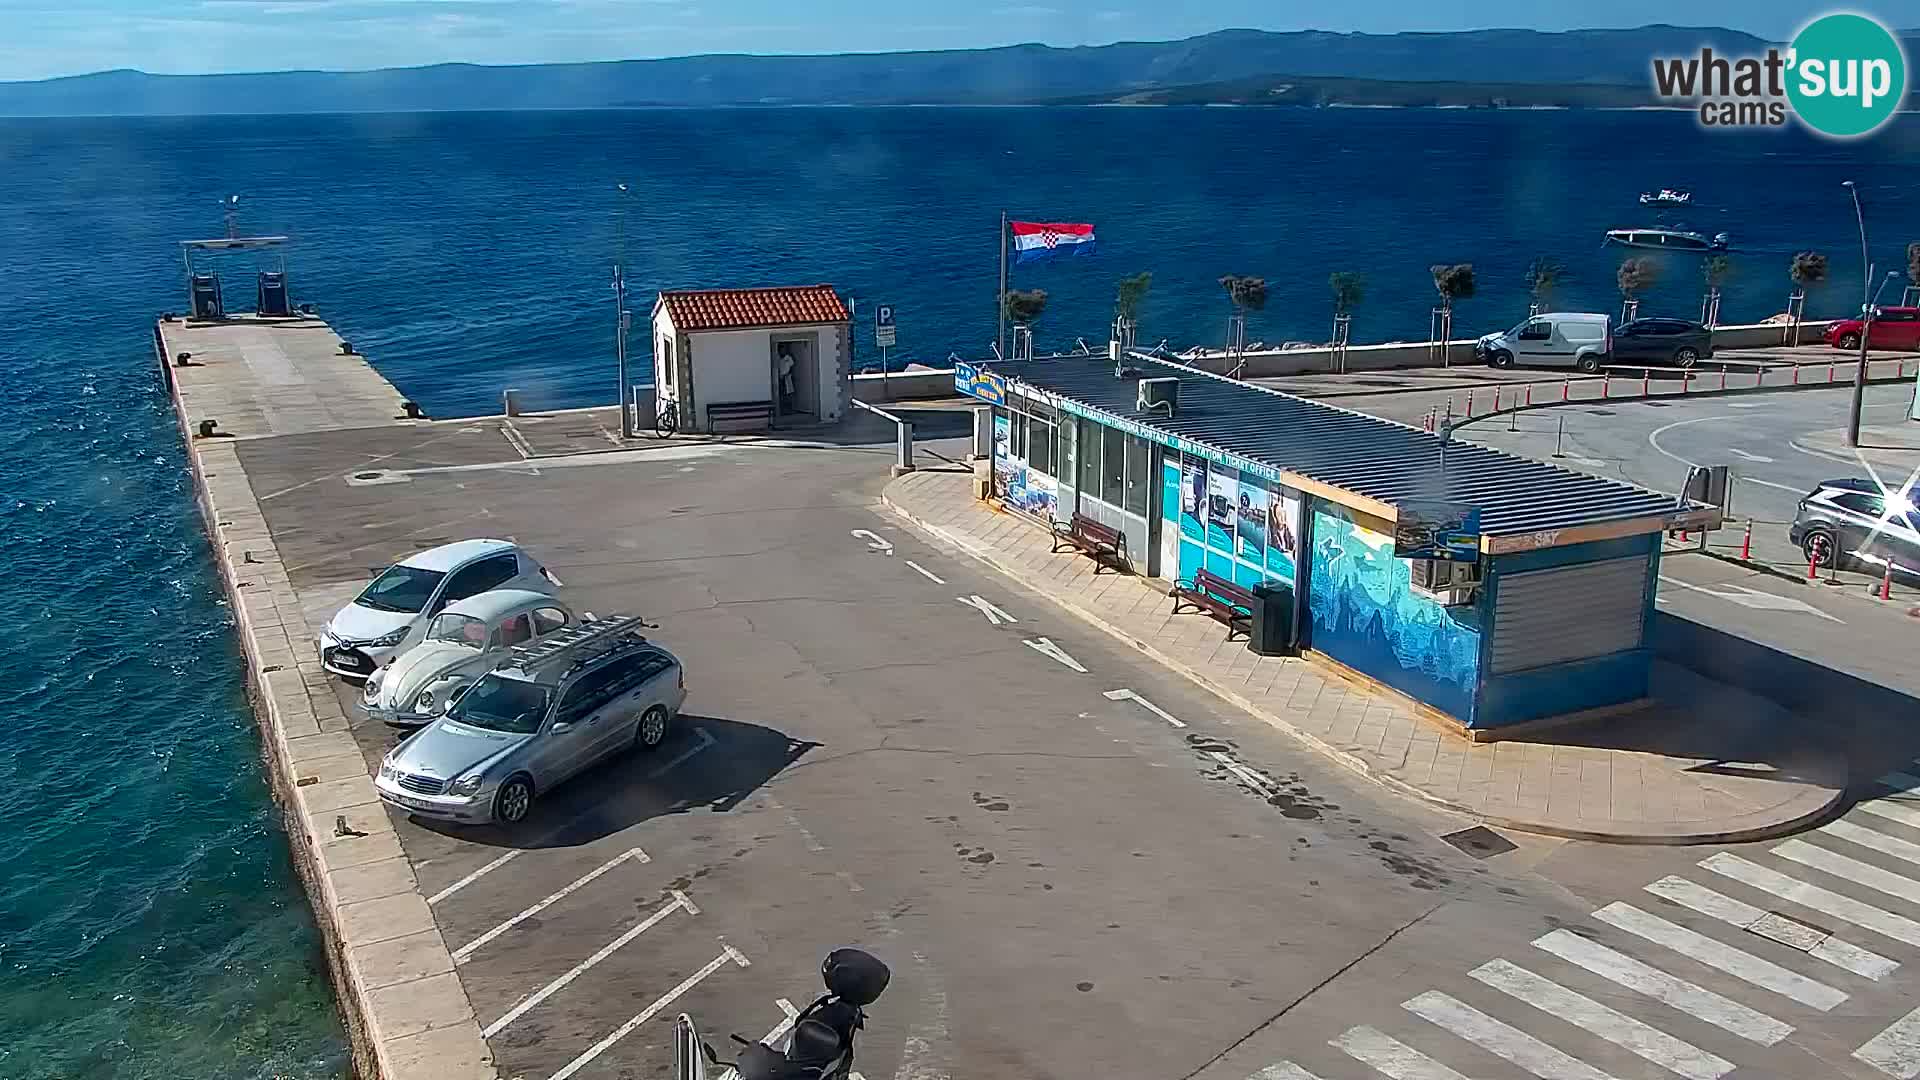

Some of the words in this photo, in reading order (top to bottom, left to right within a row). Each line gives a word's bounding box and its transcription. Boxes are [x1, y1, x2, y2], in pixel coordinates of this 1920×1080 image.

[880, 307, 891, 324] P
[1139, 426, 1168, 445] POSTAJA
[1178, 438, 1193, 452] BUS
[1193, 444, 1223, 464] STATION
[1225, 455, 1249, 472] TICKET
[1250, 464, 1277, 479] OFFICE
